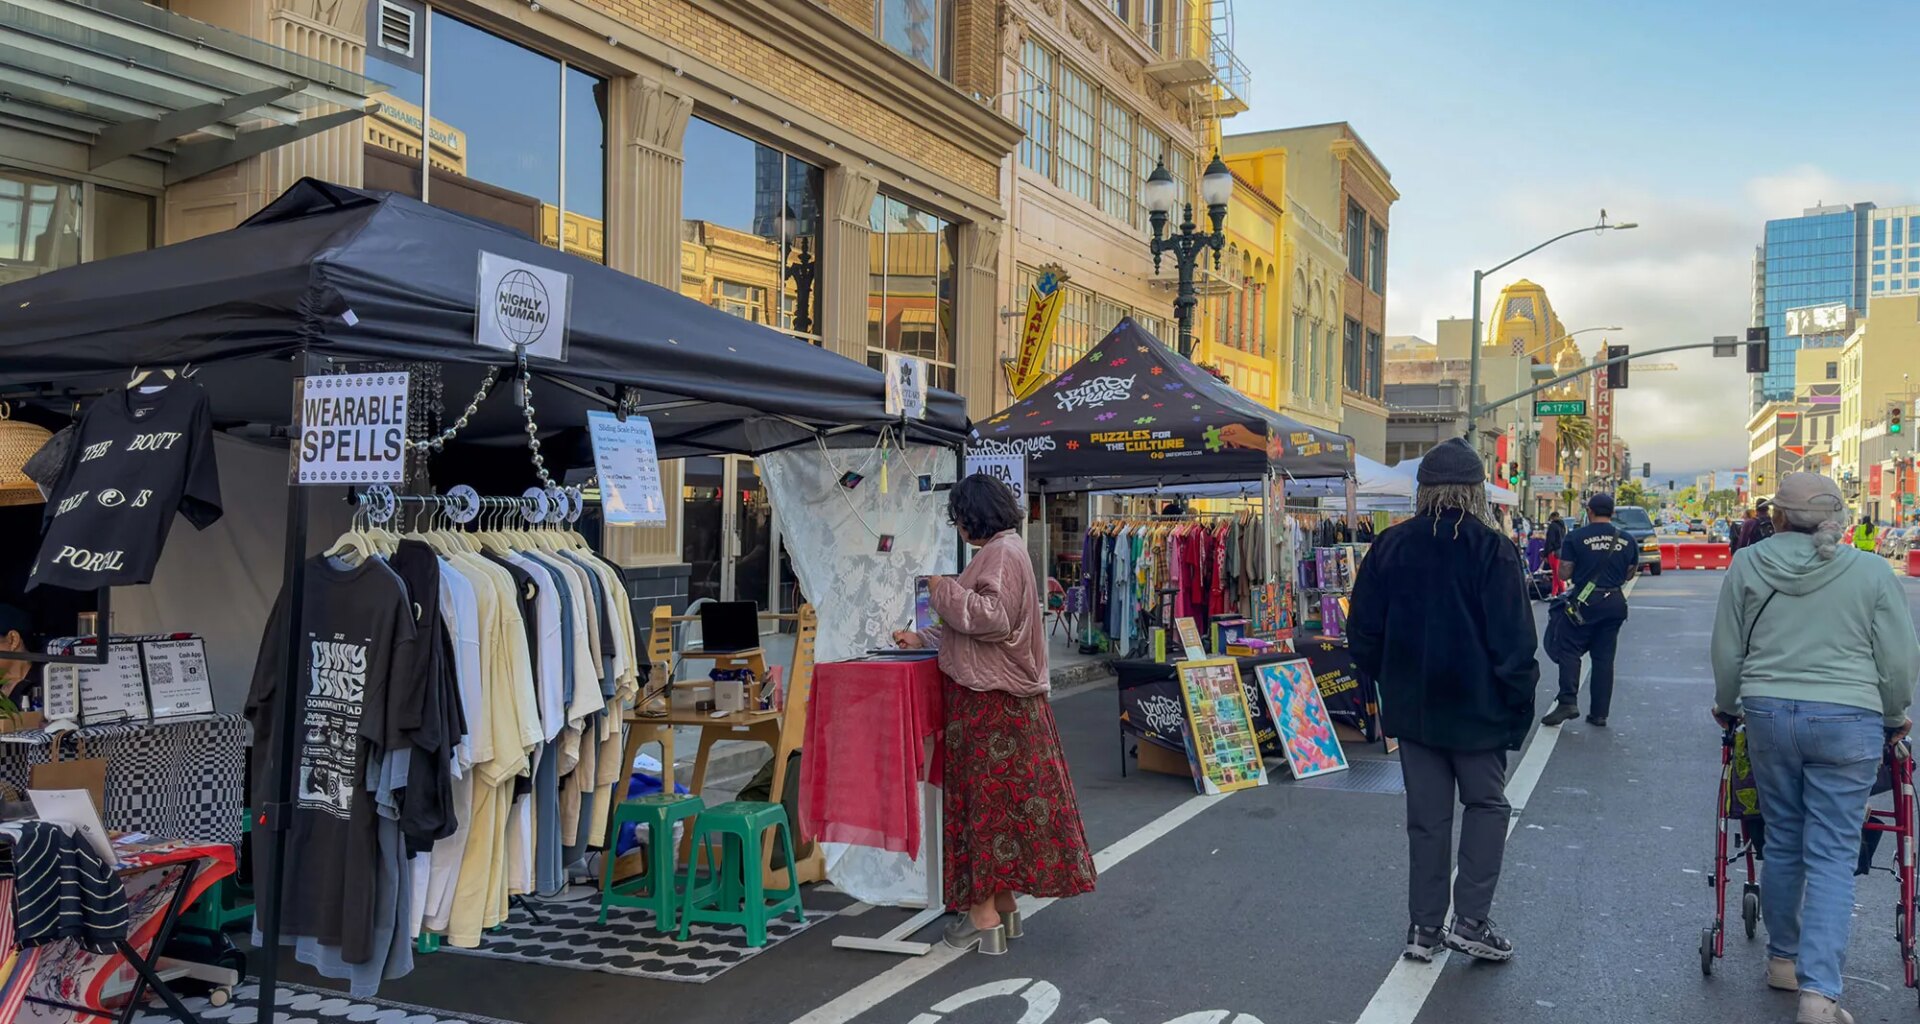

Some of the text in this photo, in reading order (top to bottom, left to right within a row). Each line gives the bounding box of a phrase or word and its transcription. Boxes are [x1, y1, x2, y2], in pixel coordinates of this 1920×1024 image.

[499, 291, 542, 311] HIGHLY
[500, 303, 546, 324] HUMAN
[1016, 301, 1047, 386] VAN KLEEF
[305, 395, 403, 427] WEARABLE
[599, 424, 616, 433] Sliding
[617, 425, 631, 433] Scale
[1597, 377, 1609, 472] OAKLAND
[302, 428, 402, 463] SPELLS
[1090, 430, 1171, 443] PUZZLES FOR
[1106, 438, 1185, 452] THE CULTURE
[80, 432, 182, 463] THE BOOTY
[975, 464, 1012, 481] AURA
[131, 489, 153, 507] IS
[1591, 542, 1622, 551] MACO
[52, 545, 124, 571] PORAL
[1320, 679, 1359, 698] ULTURE
